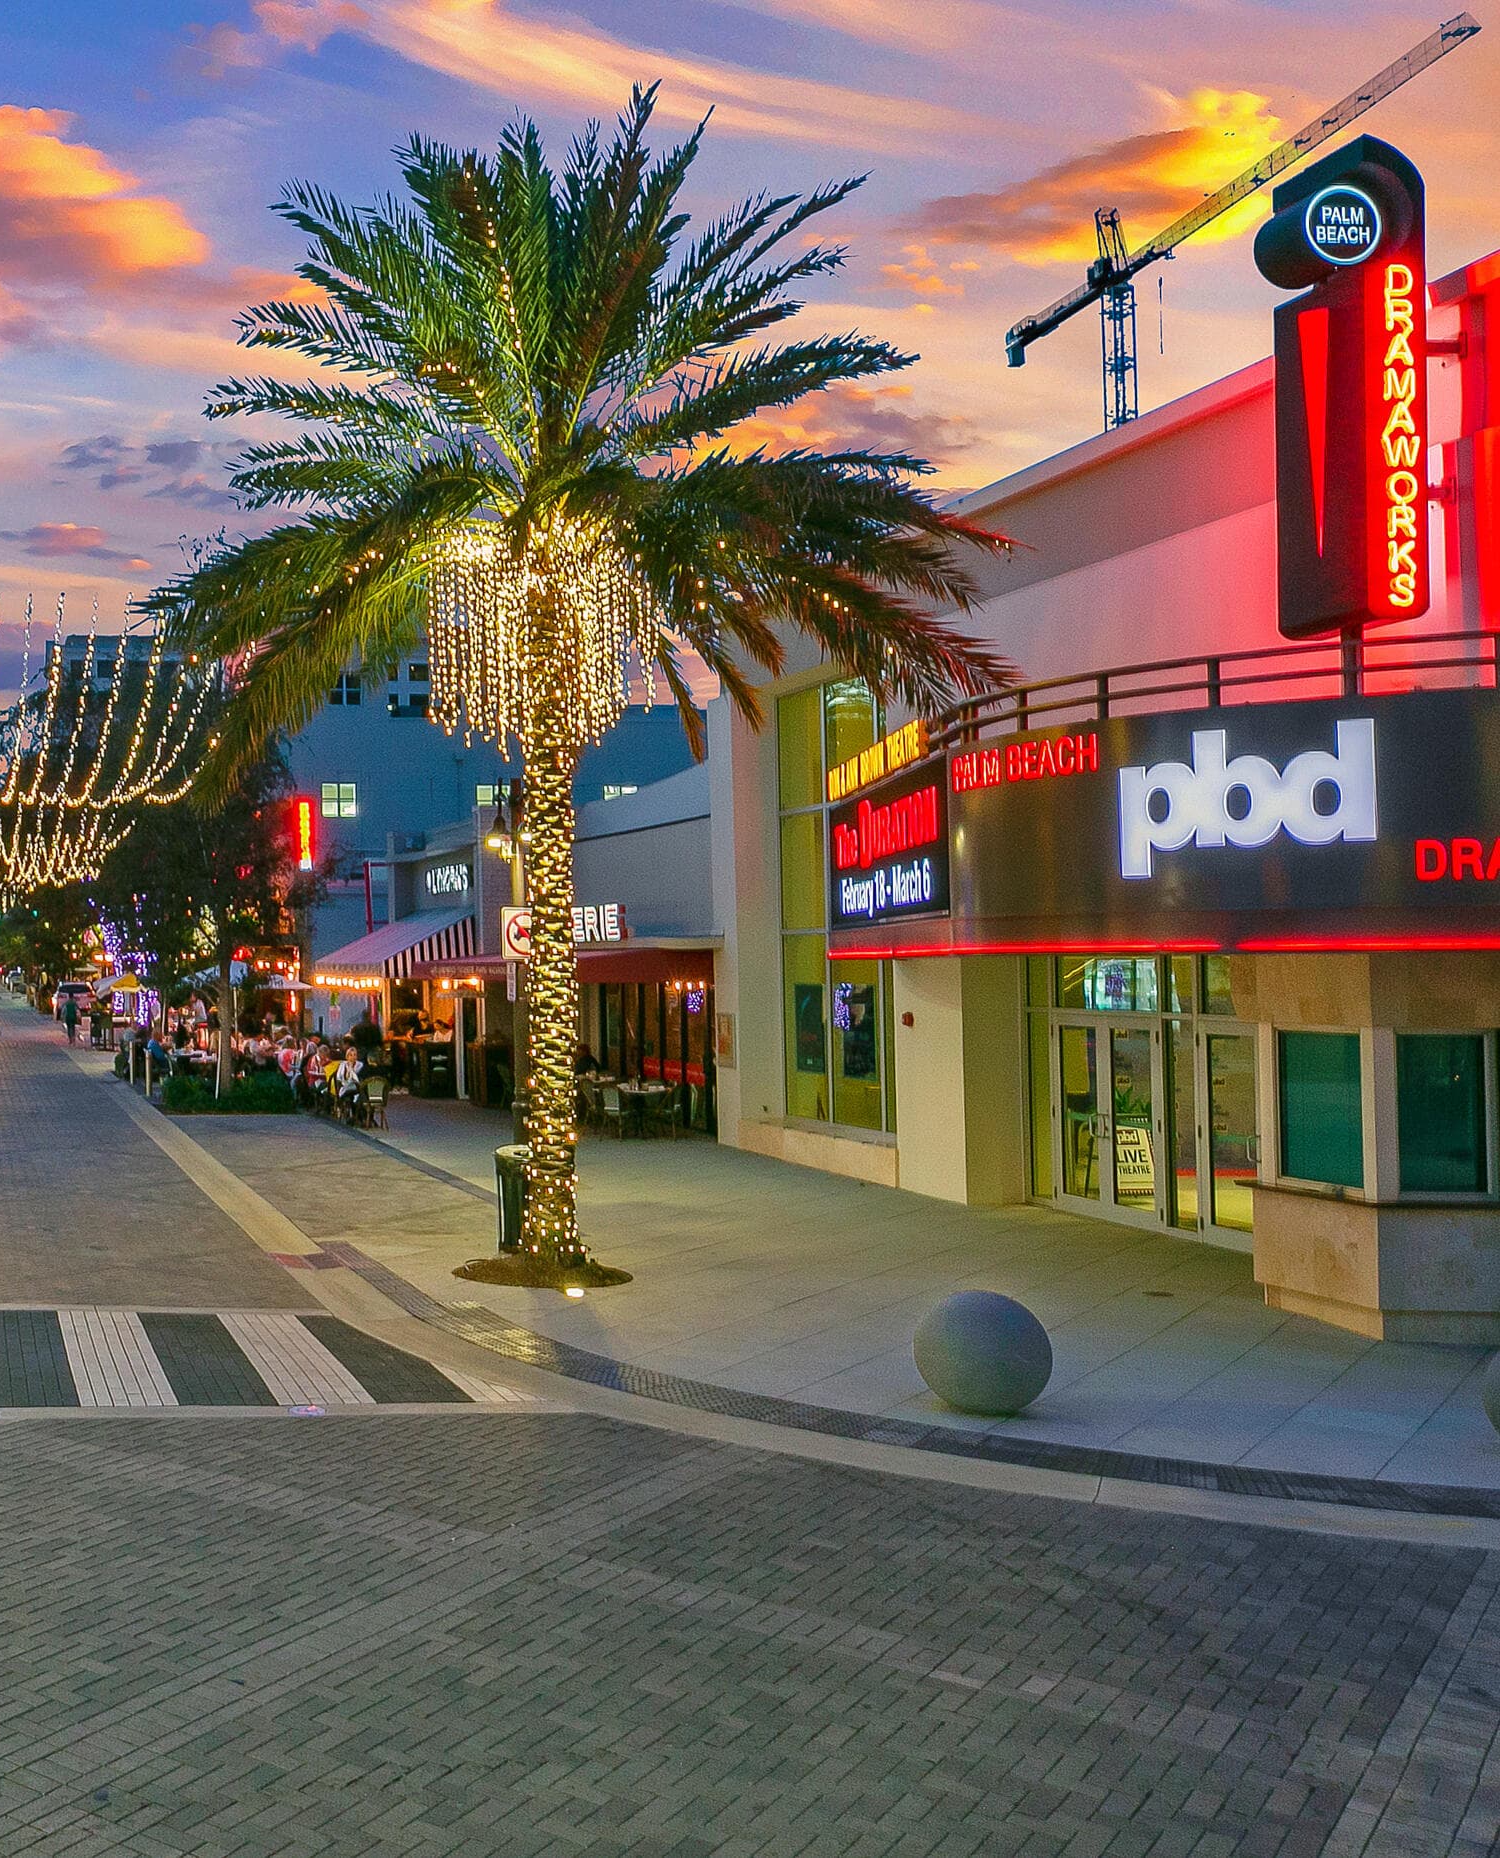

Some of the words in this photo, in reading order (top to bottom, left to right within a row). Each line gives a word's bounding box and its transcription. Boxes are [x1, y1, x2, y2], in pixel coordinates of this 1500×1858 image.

[1315, 225, 1370, 244] BEACH
[1321, 206, 1364, 225] PALM
[1381, 264, 1421, 608] DRAMAWORKS
[885, 719, 921, 774] THEATRE
[952, 748, 1001, 794] PALM
[1005, 732, 1099, 782] BEACH
[1118, 718, 1378, 880] pbd
[833, 822, 859, 870] The
[840, 877, 874, 919] February
[874, 869, 886, 909] 18
[891, 860, 922, 907] March
[922, 857, 932, 901] 6
[571, 904, 621, 942] ERIE
[1117, 1130, 1138, 1145] pbd
[1117, 1149, 1149, 1163] LIVE
[1119, 1165, 1151, 1175] THEATRE
